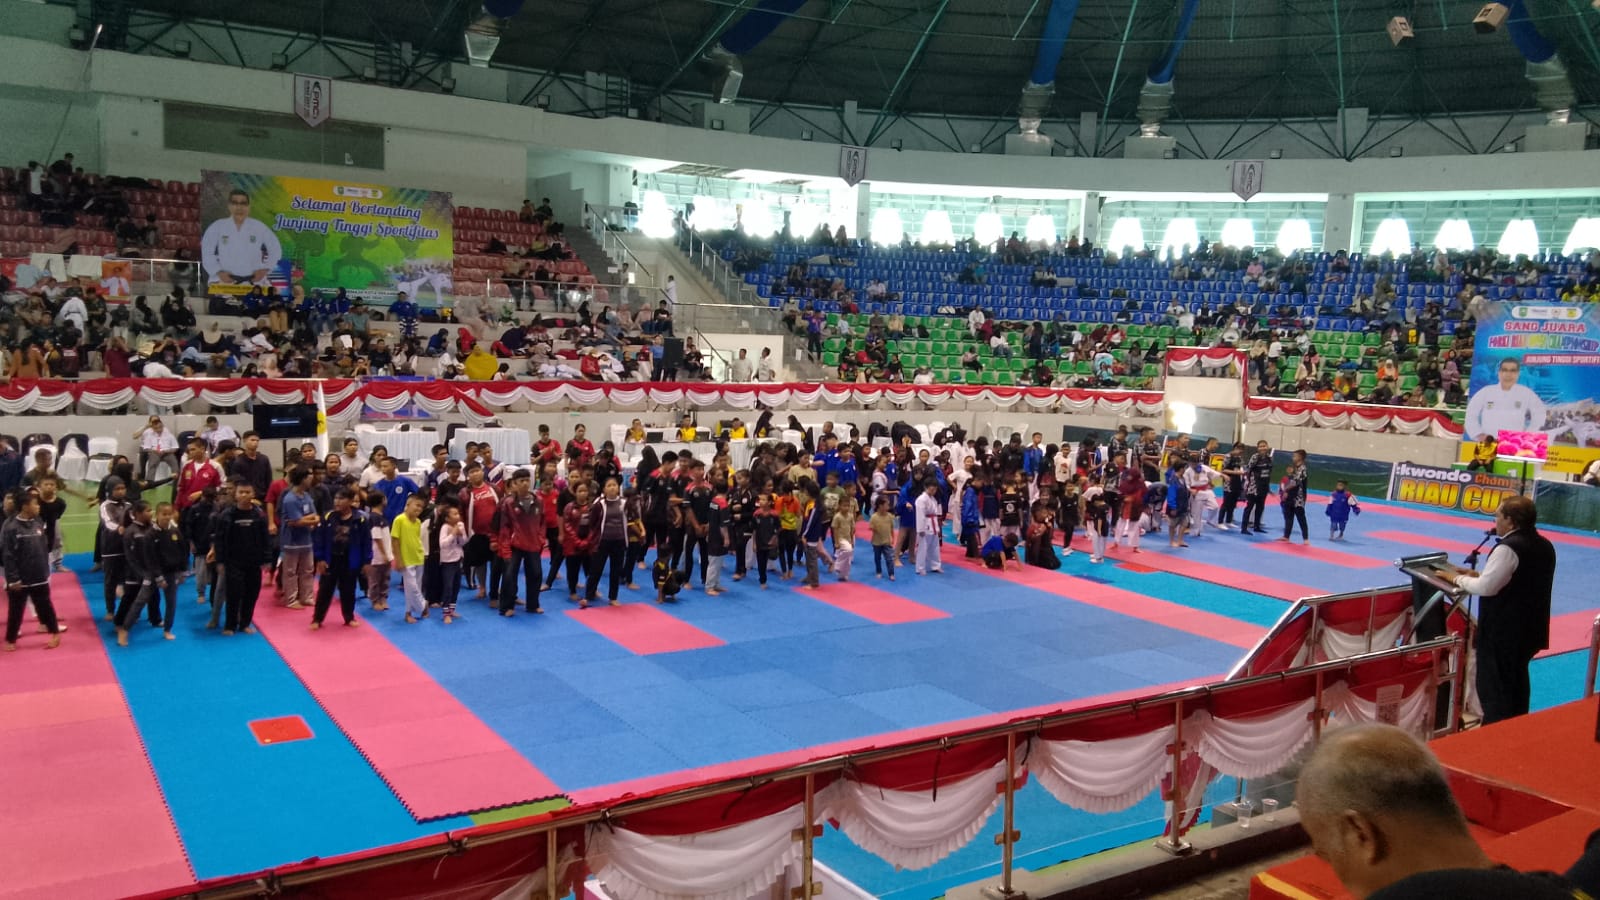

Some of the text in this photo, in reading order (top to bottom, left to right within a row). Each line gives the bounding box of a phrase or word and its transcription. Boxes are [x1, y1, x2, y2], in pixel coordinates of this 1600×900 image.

[292, 196, 422, 221] Selamat Bertanding
[273, 214, 329, 235] Junjung
[333, 218, 373, 236] Tinggi
[1541, 321, 1586, 333] JUARA
[1396, 464, 1472, 482] kwondo
[1400, 478, 1460, 509] RIAU
